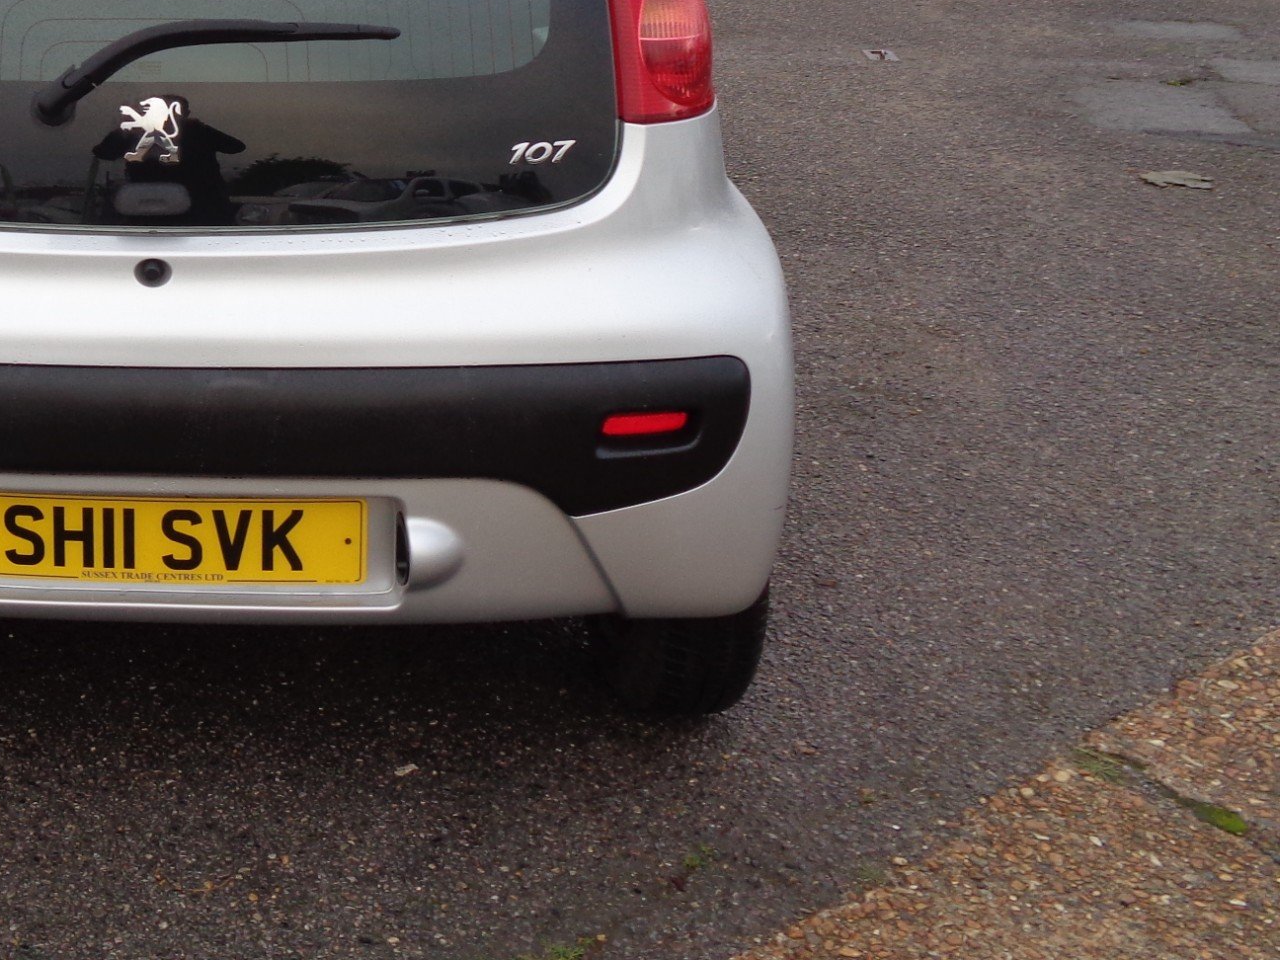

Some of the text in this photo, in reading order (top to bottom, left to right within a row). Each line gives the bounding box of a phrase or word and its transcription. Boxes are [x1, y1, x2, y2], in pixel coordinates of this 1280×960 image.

[509, 140, 577, 164] 107
[160, 508, 304, 572] SVK
[81, 570, 118, 579] SUSSEX
[121, 572, 153, 580] TRADE
[156, 573, 202, 581] CENTRES
[205, 573, 224, 581] LTD
